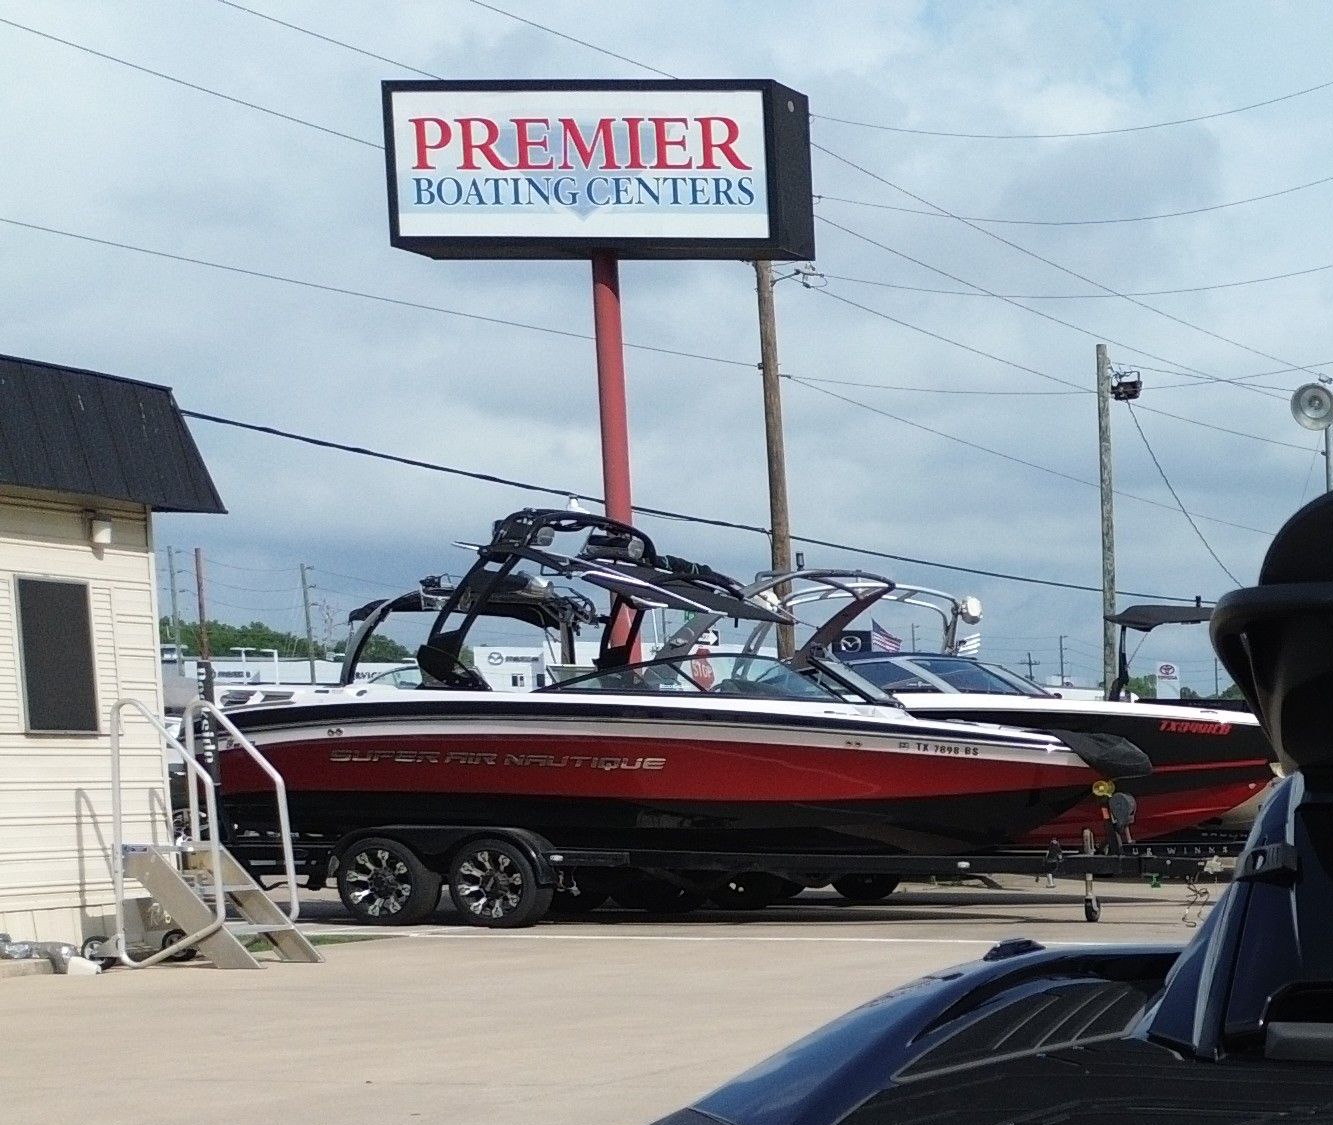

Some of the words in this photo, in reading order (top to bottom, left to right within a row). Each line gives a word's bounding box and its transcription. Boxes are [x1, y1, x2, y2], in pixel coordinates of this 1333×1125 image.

[408, 116, 752, 170] PREMIER
[413, 176, 580, 207] BOATING
[586, 176, 755, 206] CENTERS
[917, 743, 928, 751] TX
[330, 750, 441, 763] SUPER
[445, 751, 497, 765] AIR
[504, 754, 667, 770] NAUTIQUE
